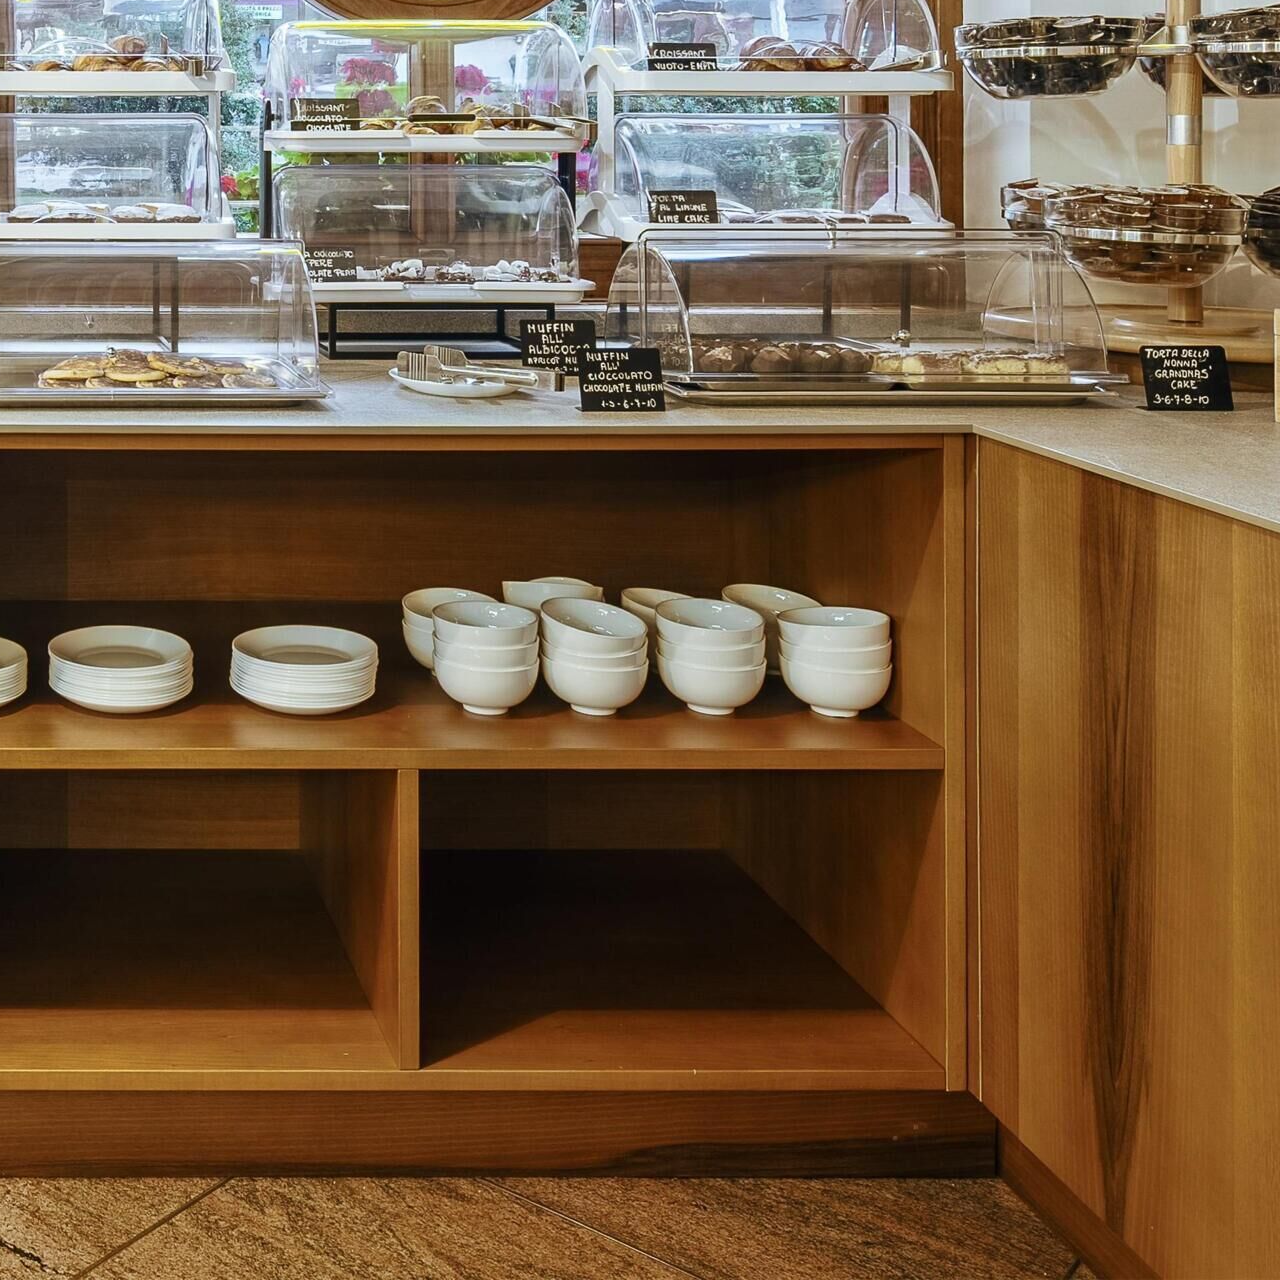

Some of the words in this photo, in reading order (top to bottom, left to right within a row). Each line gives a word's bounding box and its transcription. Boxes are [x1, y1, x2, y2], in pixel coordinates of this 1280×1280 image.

[653, 49, 706, 58] CROISSANT
[684, 214, 710, 224] CAKE
[542, 333, 565, 344] ALL'
[1144, 348, 1178, 359] TORTA
[1181, 349, 1210, 358] DELLA
[600, 361, 620, 371] ALL'
[1163, 359, 1198, 368] NONNA
[588, 371, 653, 381] CIOCCOLATO
[583, 383, 632, 393] CHOCOLATE
[1171, 380, 1198, 390] CAKE
[1153, 393, 1210, 405] 3-6-7-8-10
